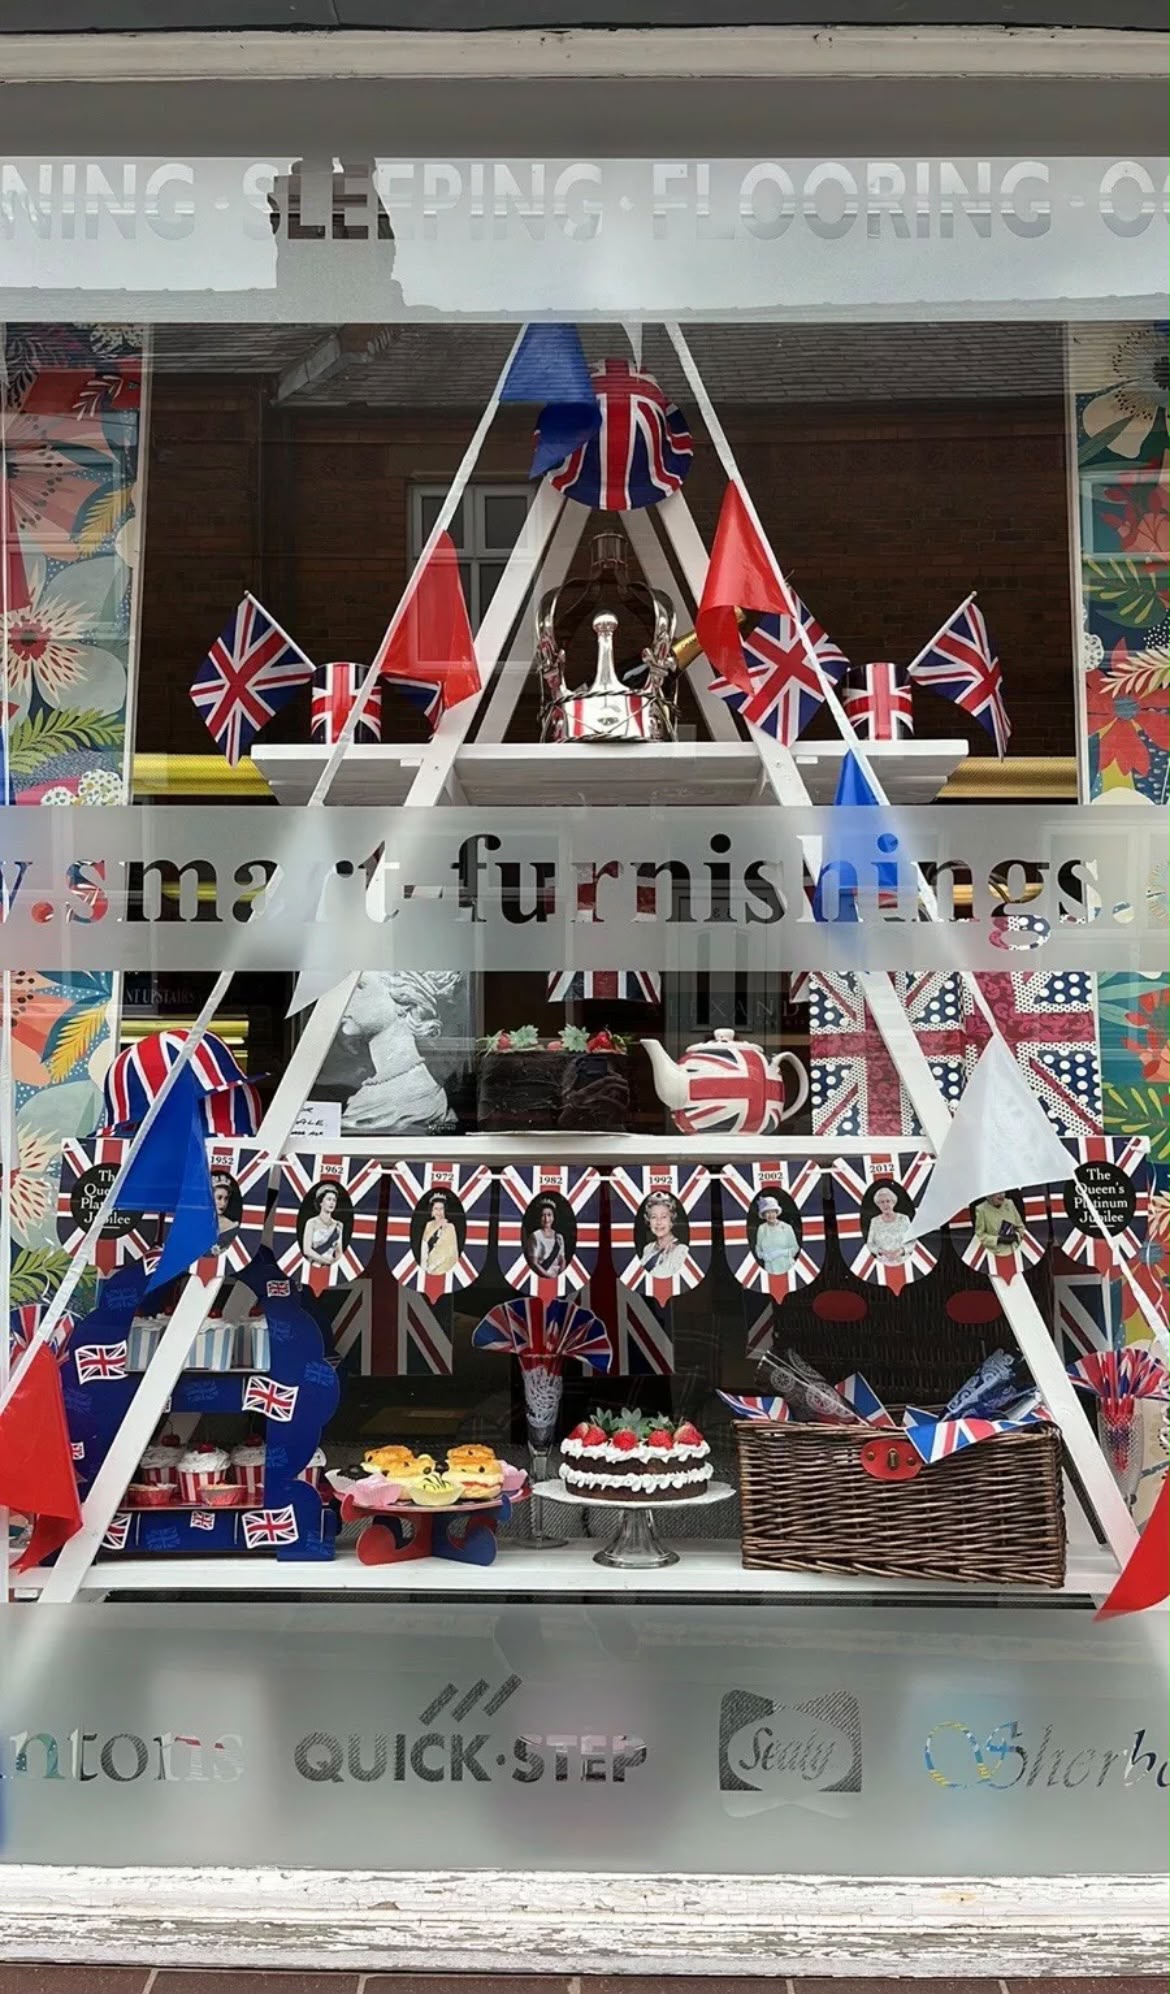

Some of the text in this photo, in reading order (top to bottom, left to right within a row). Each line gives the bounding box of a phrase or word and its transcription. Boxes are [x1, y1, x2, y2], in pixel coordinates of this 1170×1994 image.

[3, 161, 1170, 240] NING SLEEPING FLOORING O
[211, 1156, 234, 1165] 1952
[320, 1165, 344, 1175] 1962
[870, 1163, 895, 1174] 2012
[1086, 1168, 1111, 1181] The
[98, 1169, 116, 1182] Th
[431, 1172, 454, 1182] 1972
[539, 1176, 563, 1185] 1982
[649, 1176, 673, 1185] 1992
[758, 1172, 783, 1182] 2002
[1075, 1181, 1125, 1197] Queen's
[1074, 1196, 1128, 1209] Pltinum
[83, 1211, 131, 1224] Jilee
[0, 1727, 246, 1783] ntons
[738, 1726, 836, 1781] Sealy
